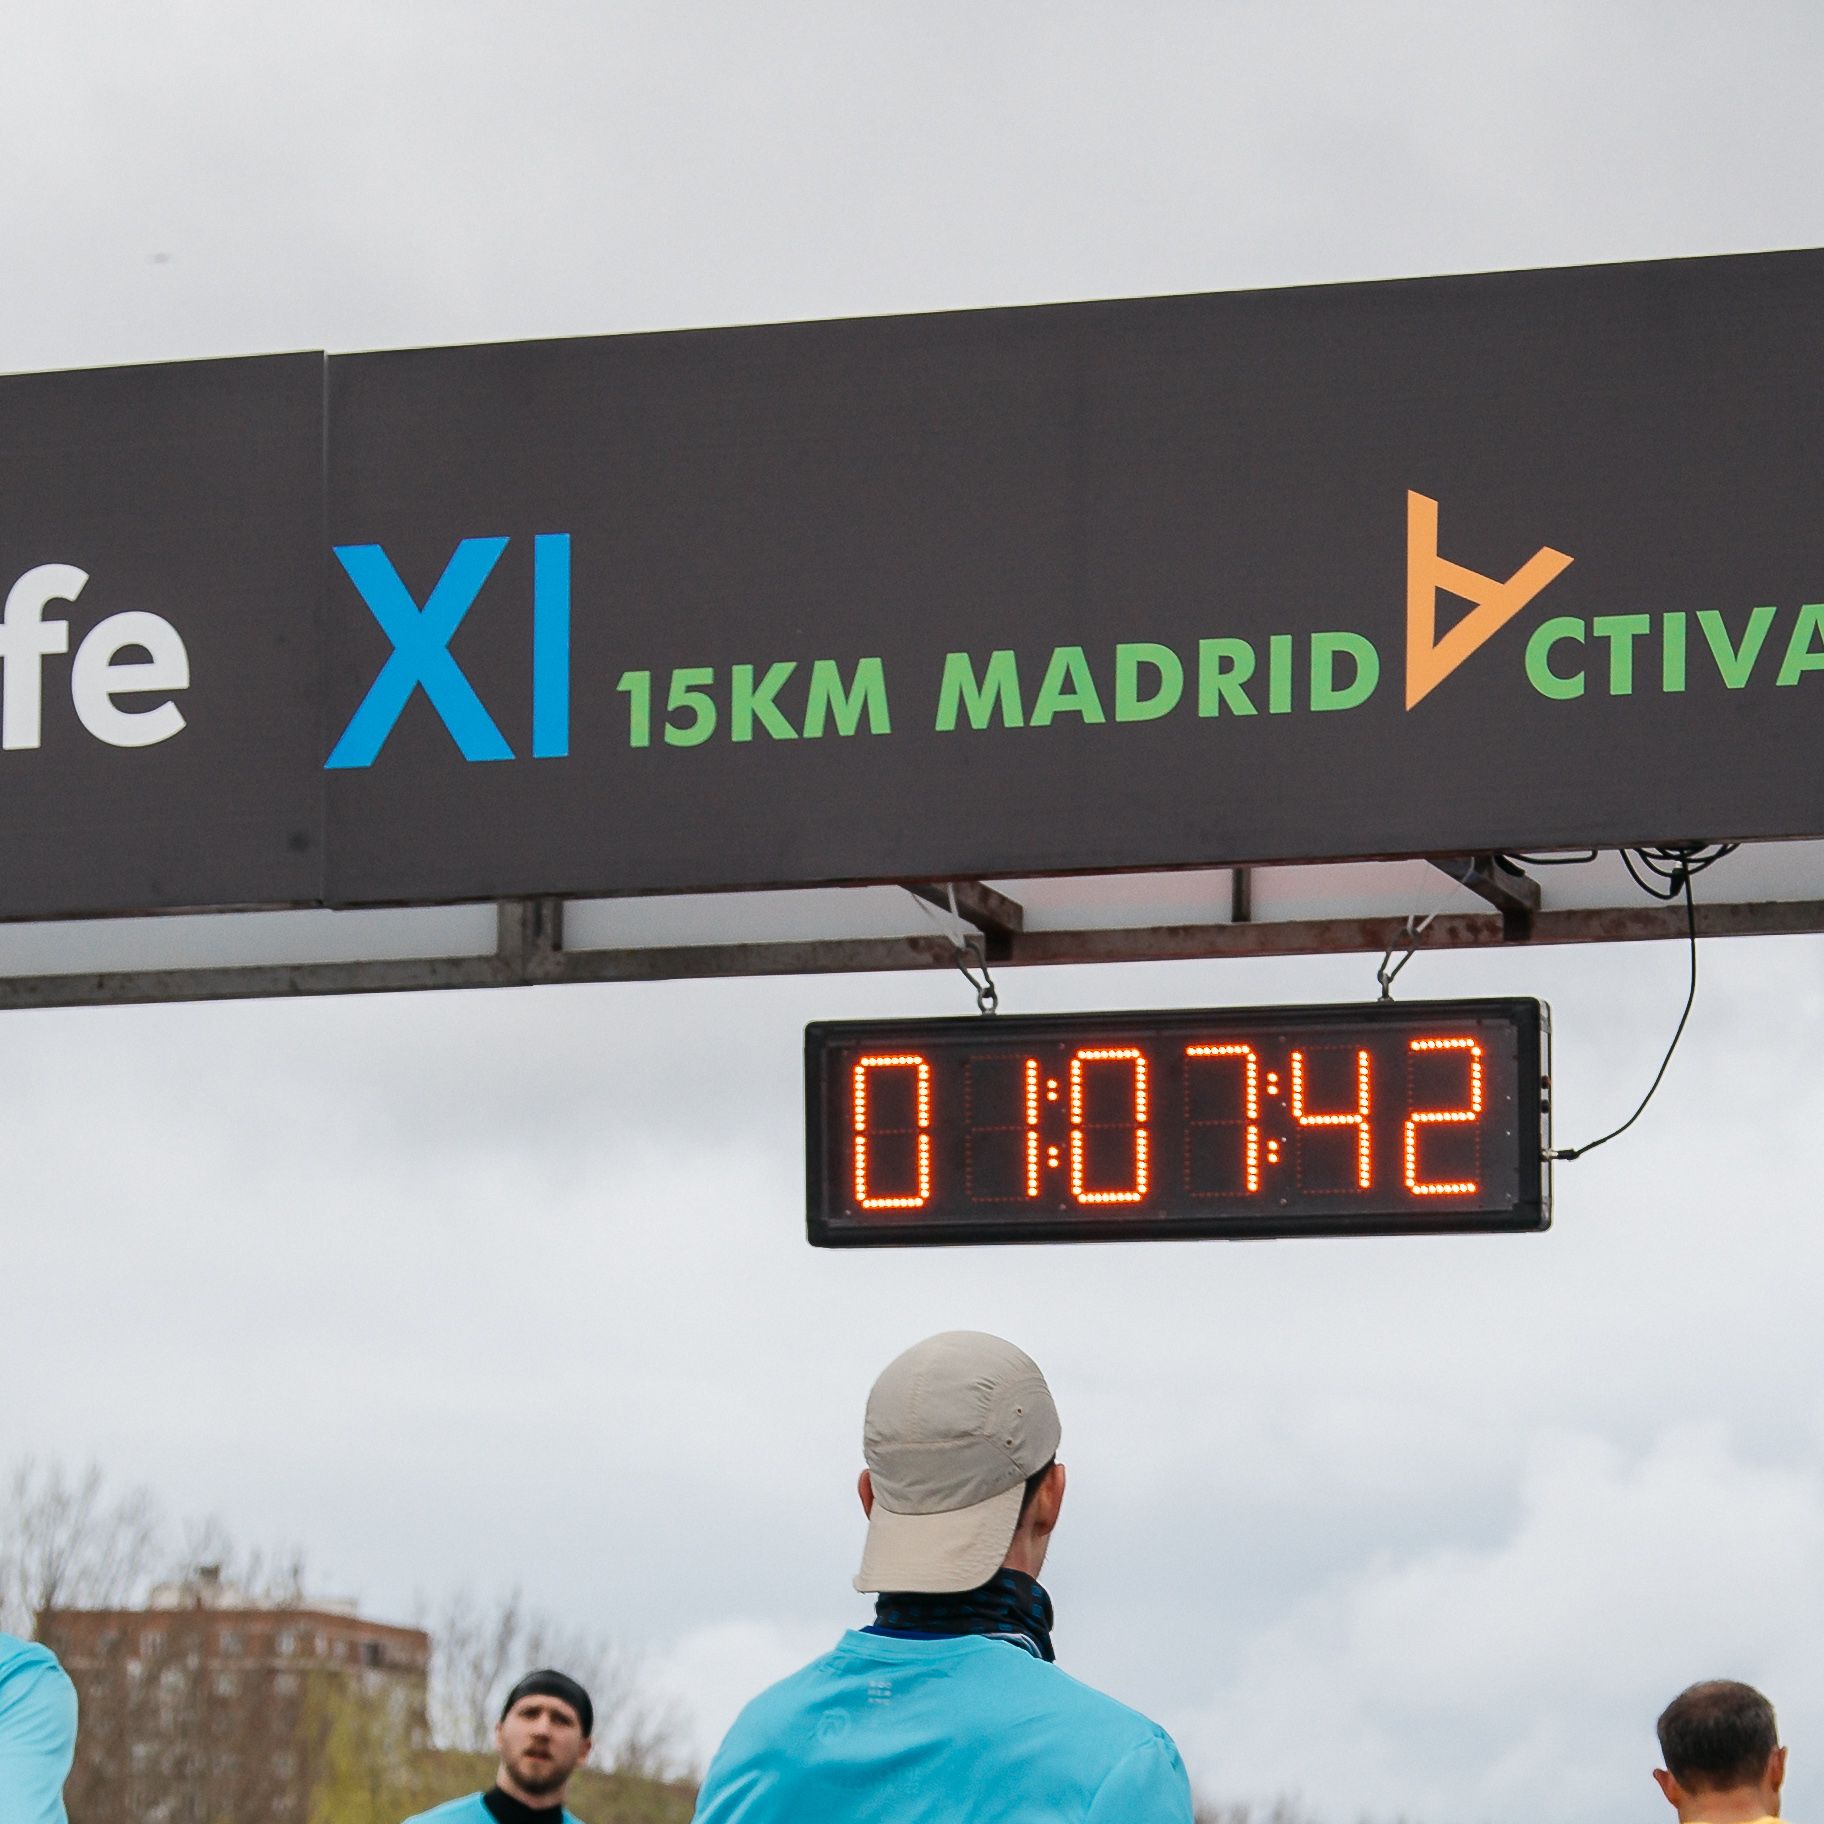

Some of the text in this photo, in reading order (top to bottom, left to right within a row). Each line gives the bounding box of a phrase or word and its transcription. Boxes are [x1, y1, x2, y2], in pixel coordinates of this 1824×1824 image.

[324, 531, 570, 769] XI
[617, 654, 891, 748] 15KM
[936, 631, 1381, 732] MADRID
